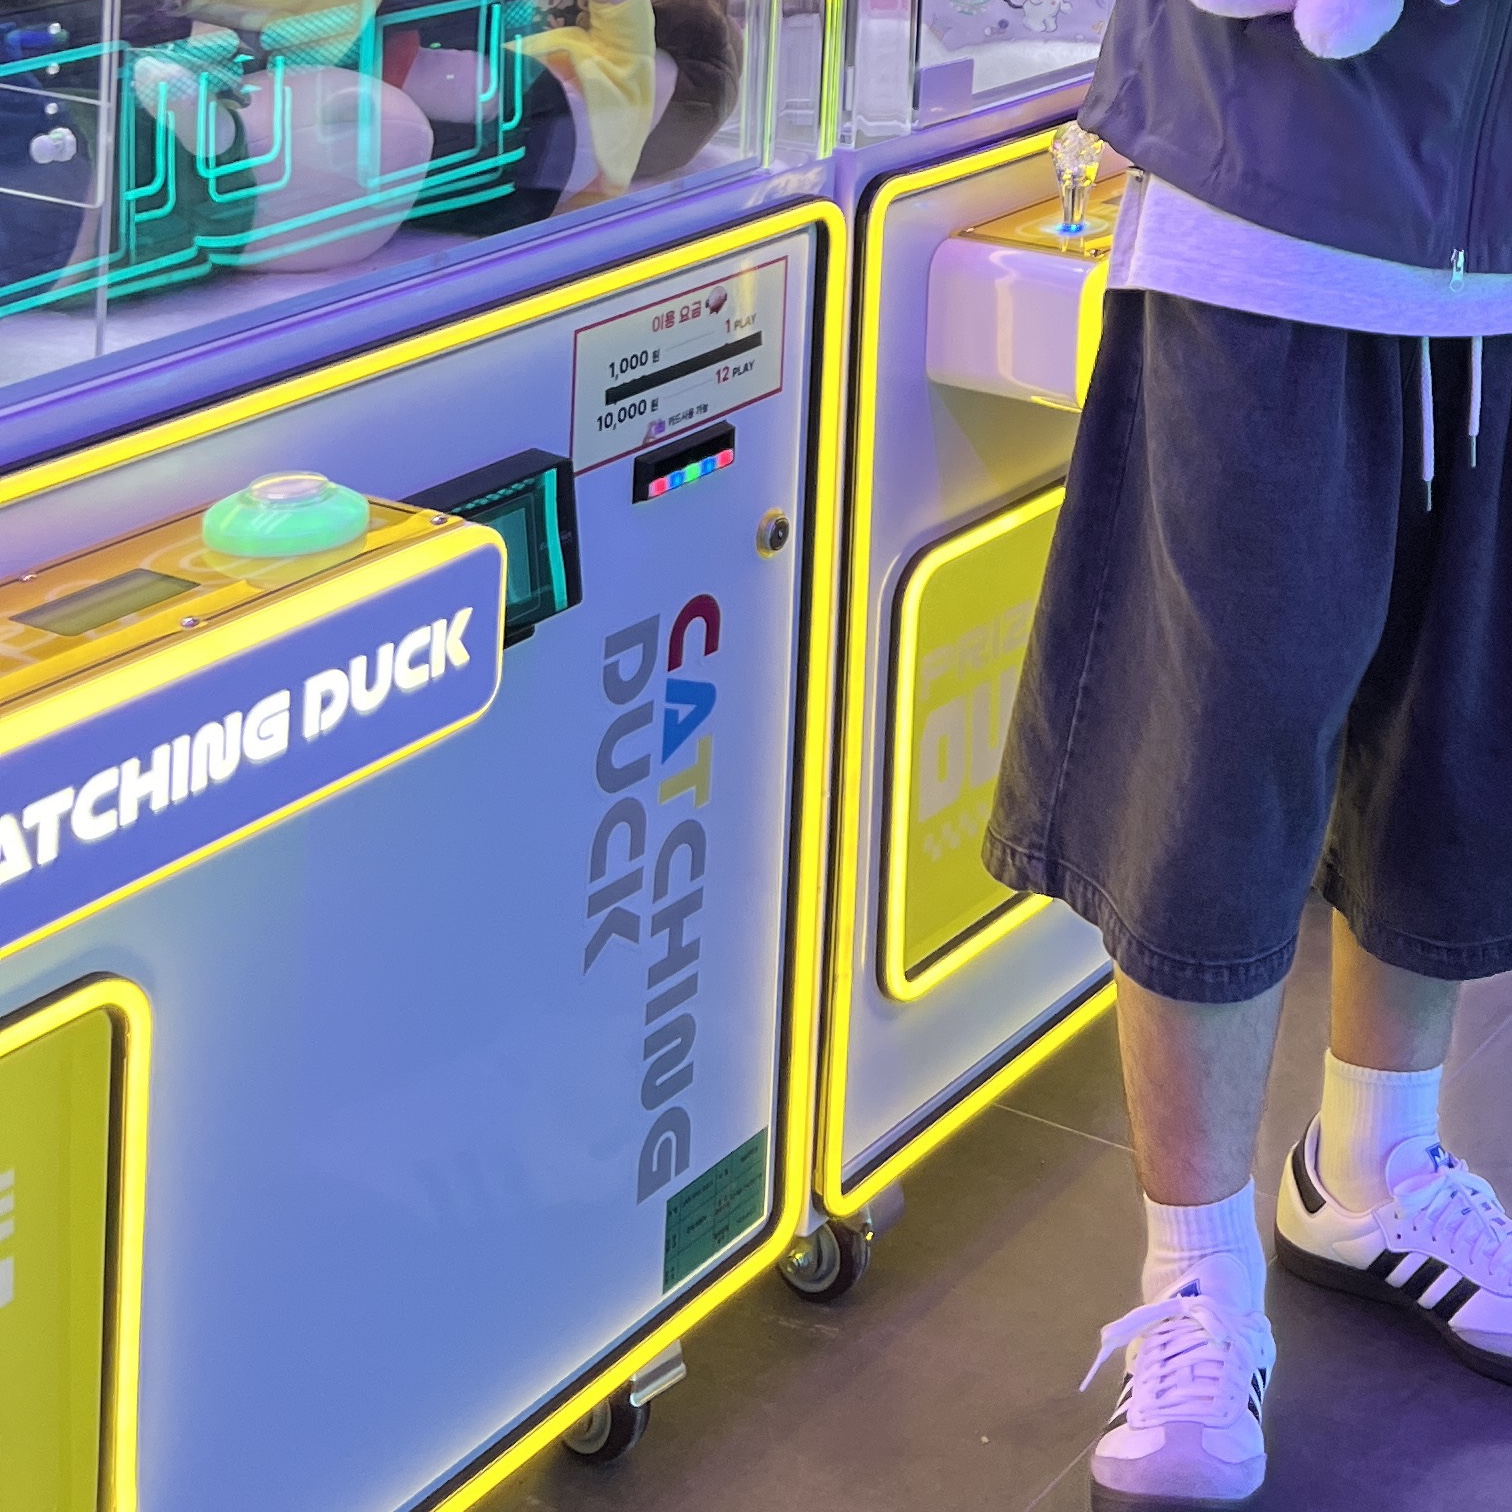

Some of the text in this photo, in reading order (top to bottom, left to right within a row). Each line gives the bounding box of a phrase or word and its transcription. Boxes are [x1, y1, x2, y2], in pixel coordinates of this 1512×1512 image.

[608, 313, 757, 381] 1,000 원 1 PLAY
[652, 300, 702, 333] 이용 요금
[596, 359, 756, 432] 10,000 원 12 PLAY
[303, 606, 474, 740] DUCK
[919, 598, 1036, 702] PRIZ
[583, 612, 661, 977] DUCK
[636, 593, 722, 1205] CATCHING
